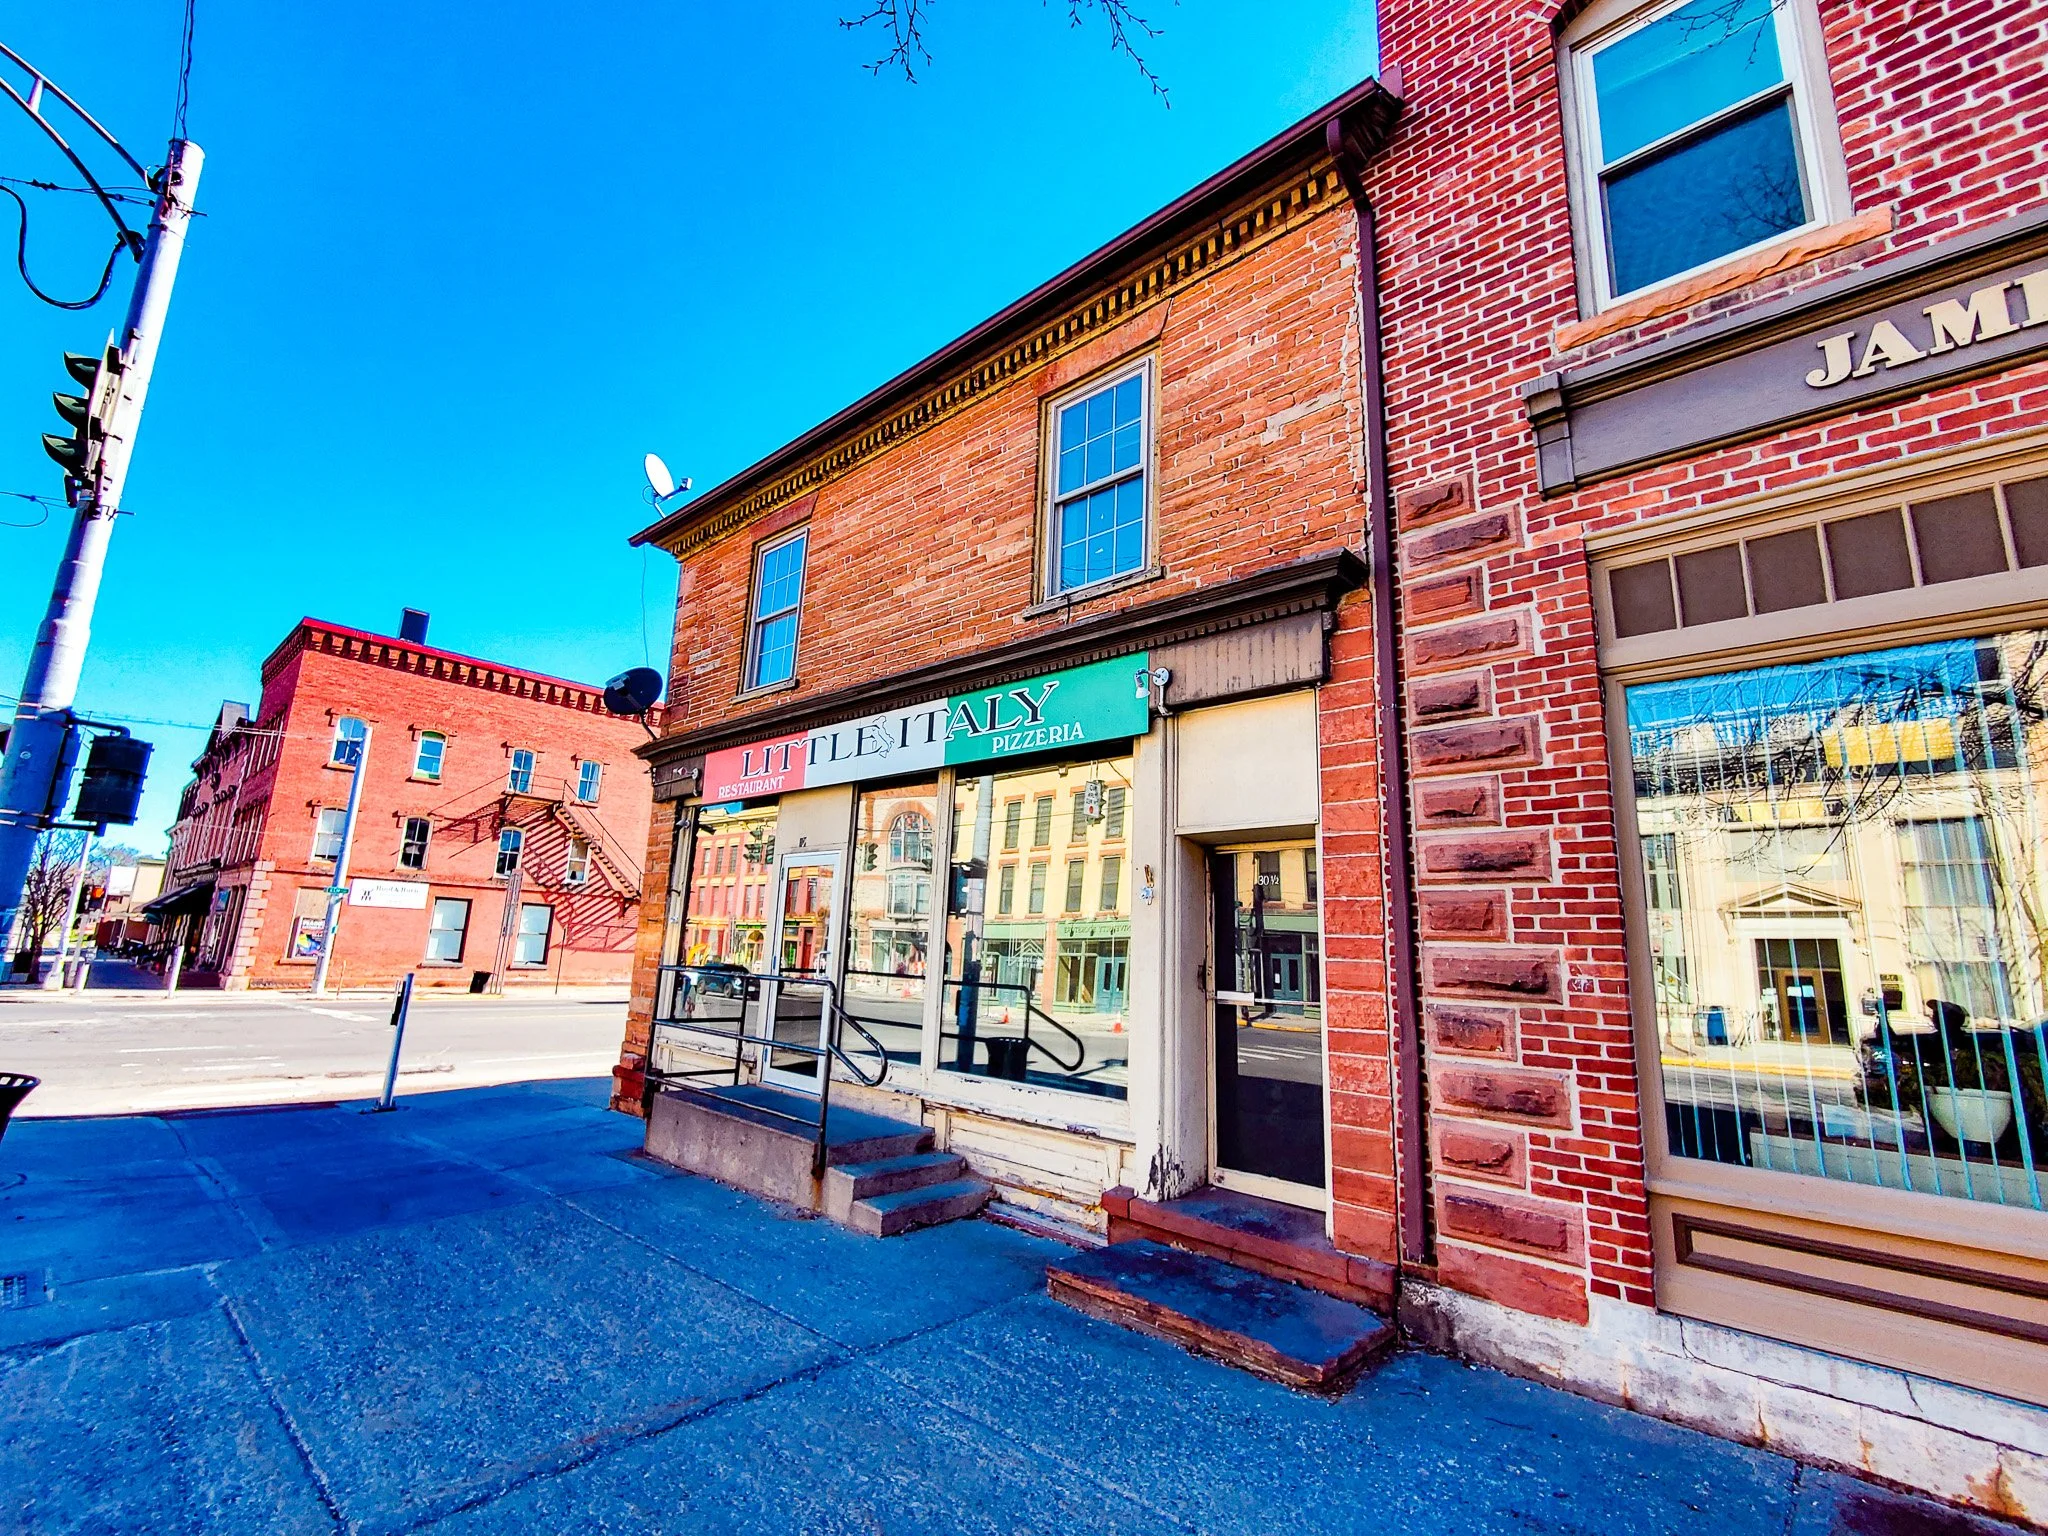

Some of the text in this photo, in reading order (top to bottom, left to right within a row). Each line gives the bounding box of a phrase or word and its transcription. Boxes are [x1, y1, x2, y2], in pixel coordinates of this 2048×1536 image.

[741, 680, 1060, 780] LITTLE ITALY
[992, 722, 1086, 754] PIZZERIA
[718, 776, 785, 799] RESTAURANT
